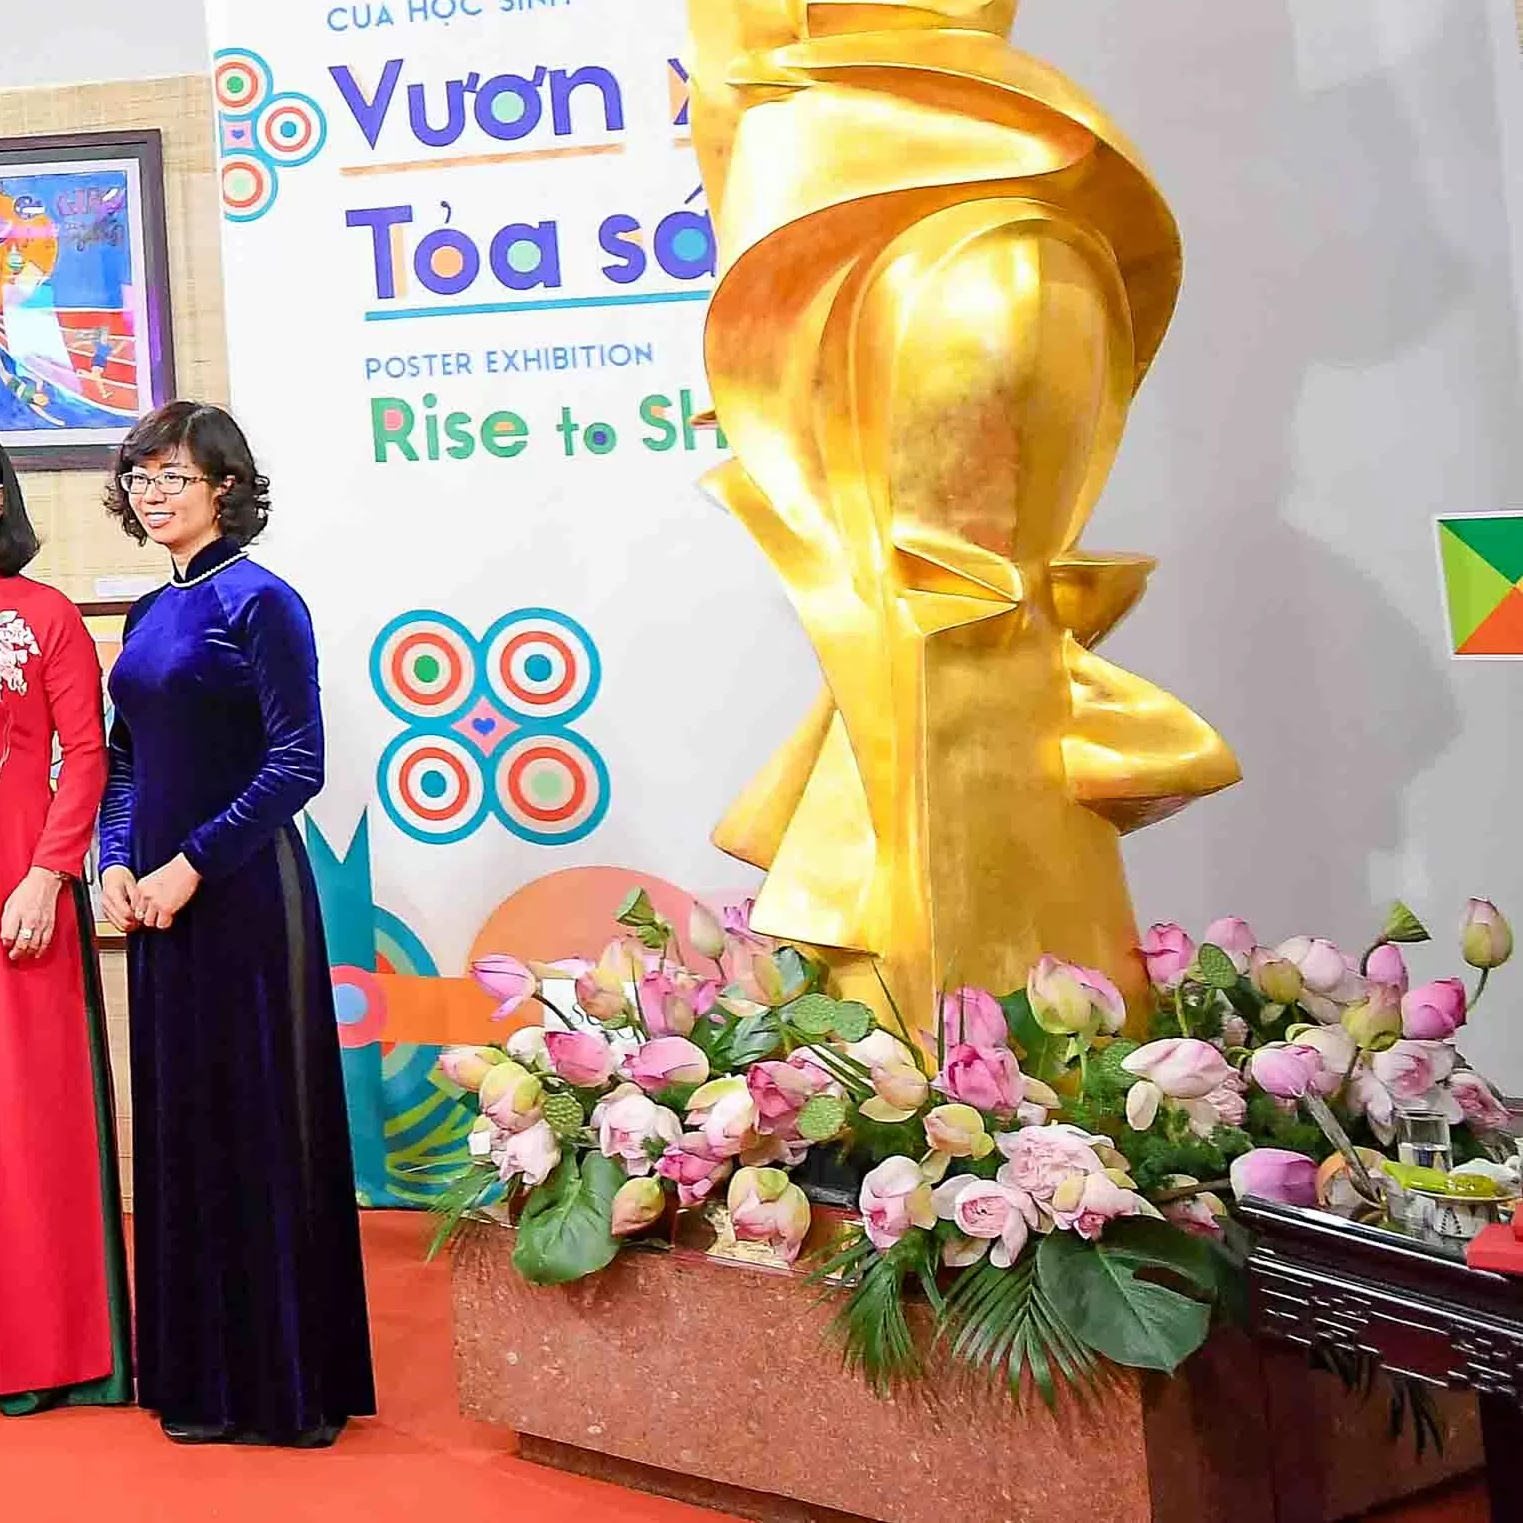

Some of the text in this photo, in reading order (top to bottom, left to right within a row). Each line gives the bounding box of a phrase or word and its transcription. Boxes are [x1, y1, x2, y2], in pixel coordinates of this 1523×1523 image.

[328, 58, 626, 151] Vươn
[346, 200, 562, 300] Tỏa
[365, 343, 655, 380] POSTER EXHIBITION
[370, 393, 529, 463] Rise
[557, 406, 617, 457] to
